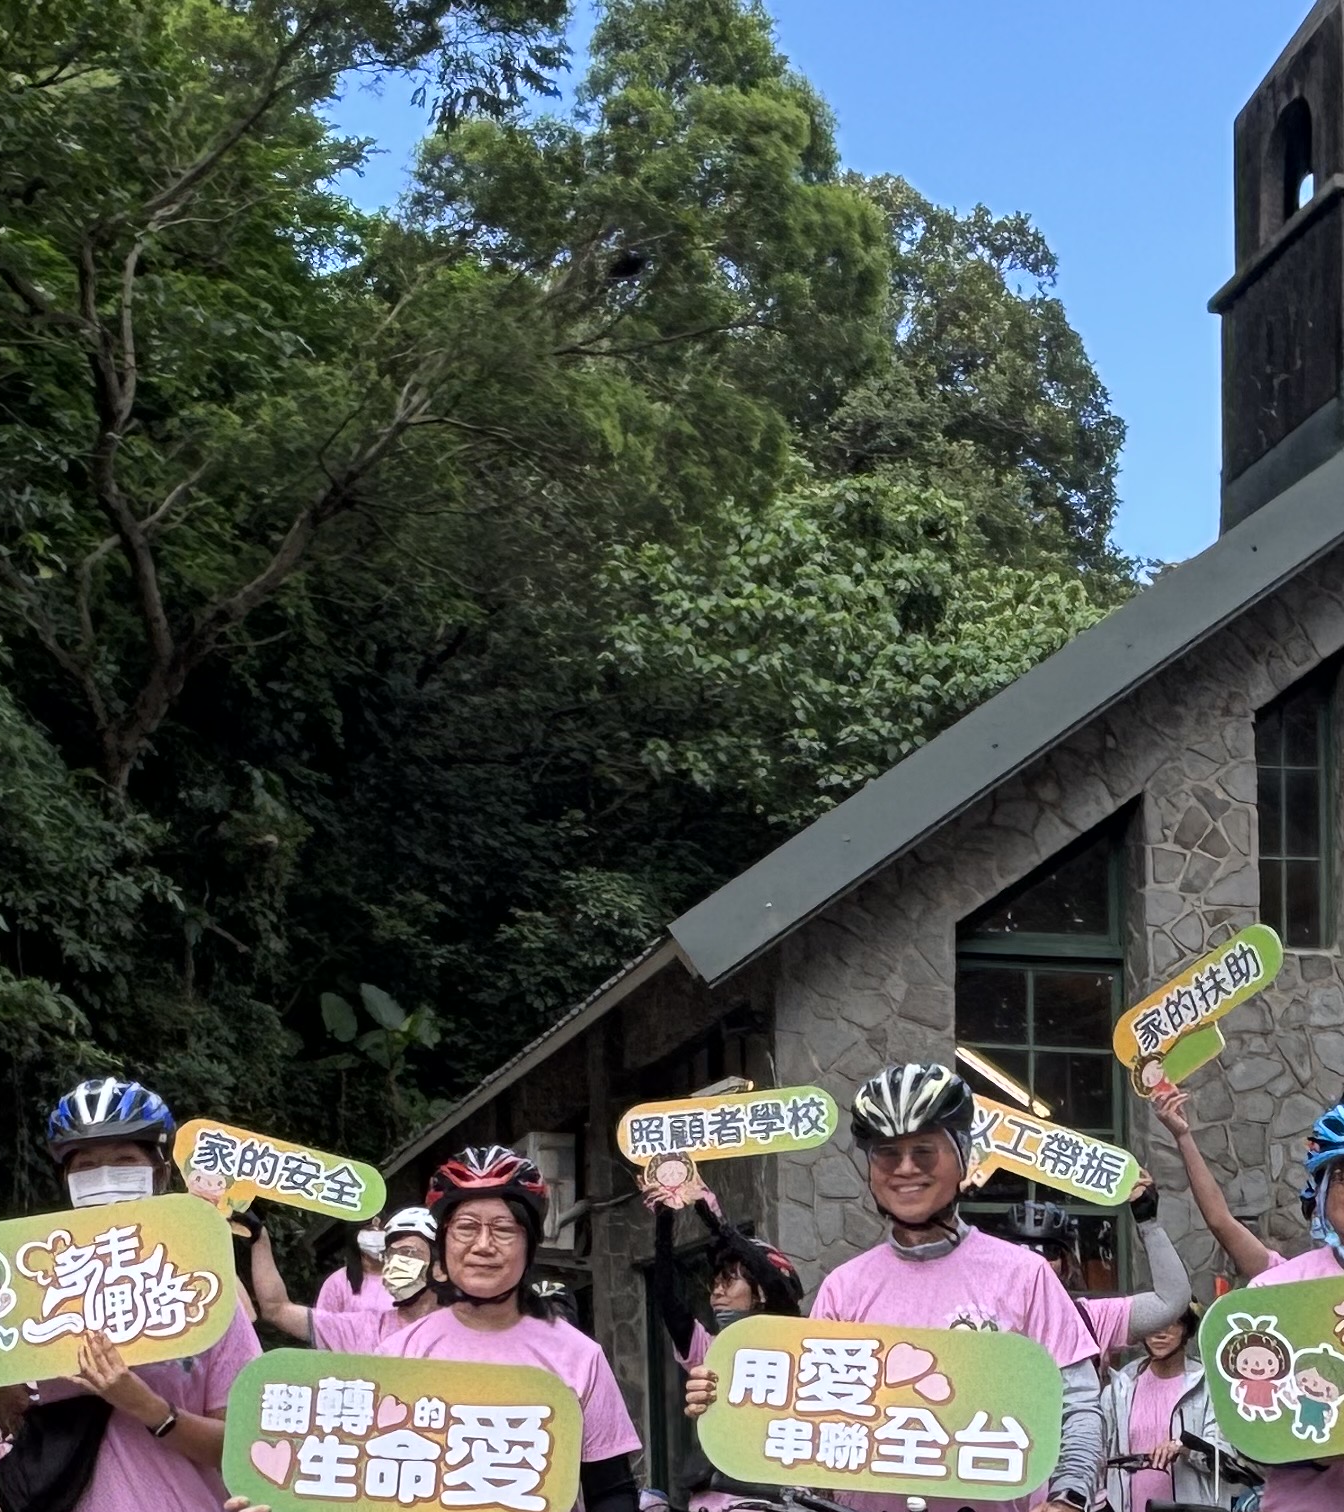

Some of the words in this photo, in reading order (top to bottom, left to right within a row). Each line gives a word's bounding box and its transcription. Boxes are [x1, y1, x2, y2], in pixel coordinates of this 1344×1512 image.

[1134, 943, 1262, 1051] 家的扶助
[630, 1097, 826, 1155] 照顧者學校
[193, 1131, 363, 1208] 家的安全
[728, 1338, 881, 1417] 用愛
[764, 1406, 1030, 1482] 串聯全台
